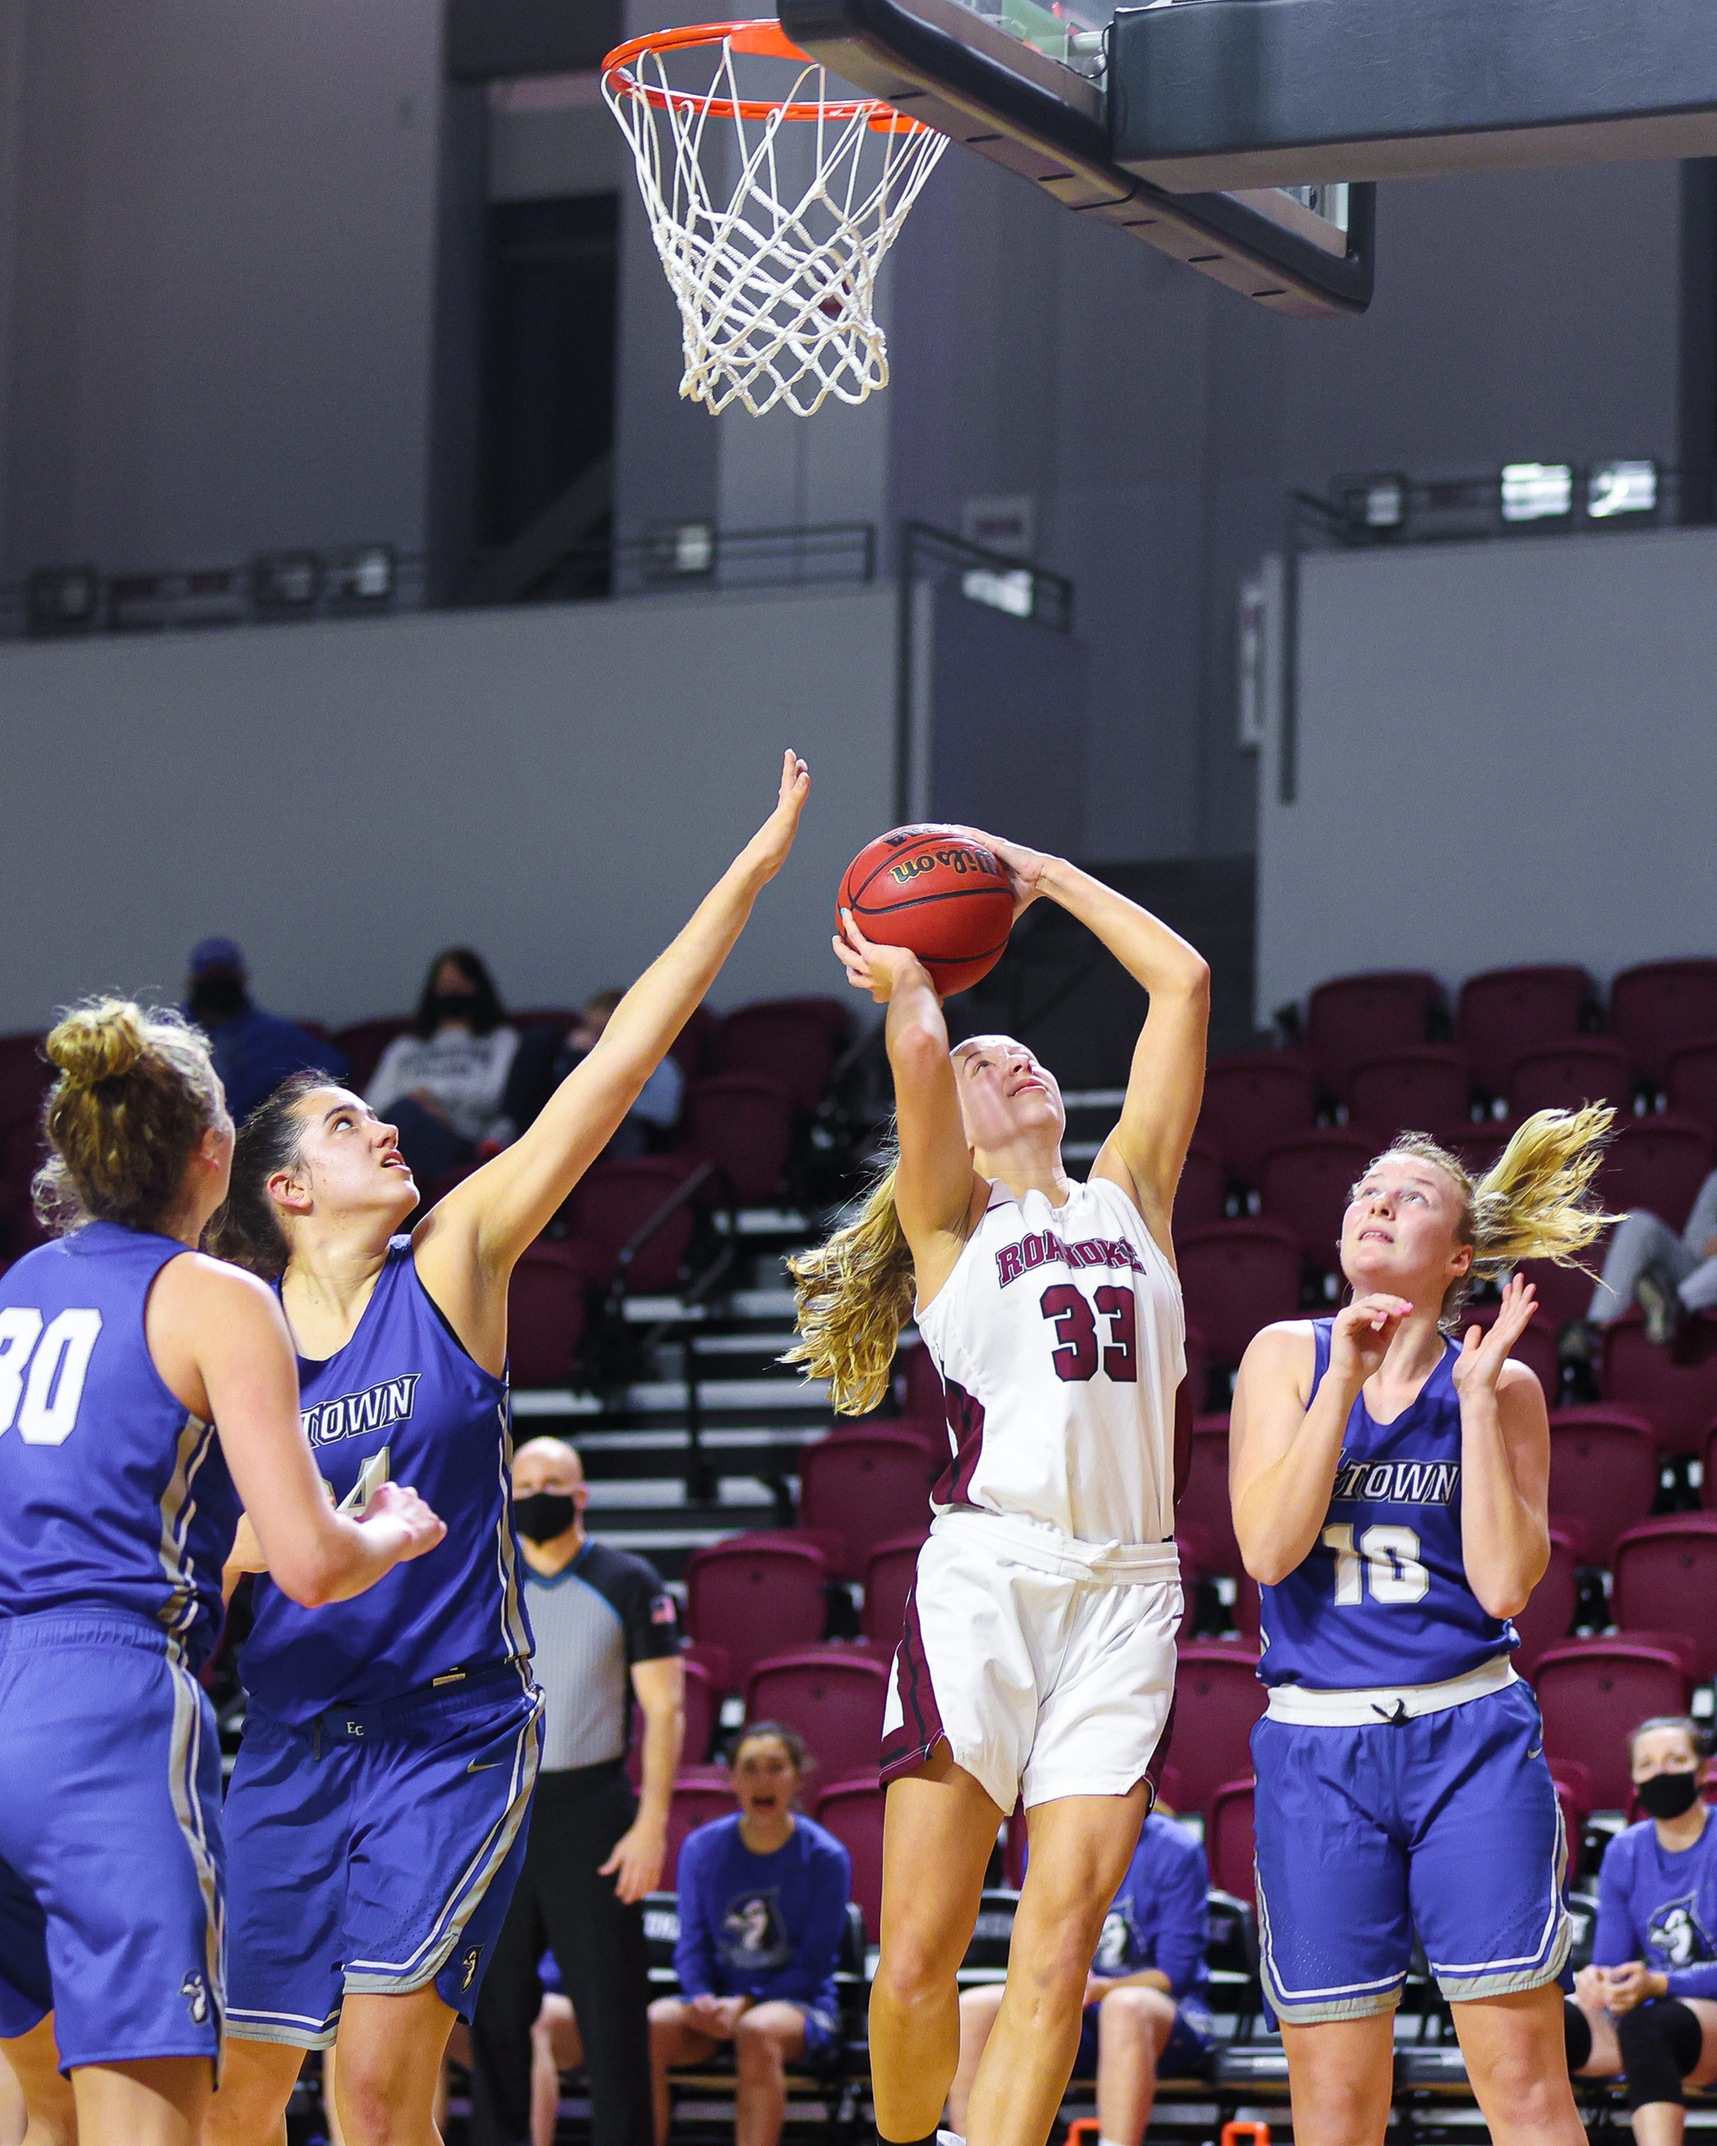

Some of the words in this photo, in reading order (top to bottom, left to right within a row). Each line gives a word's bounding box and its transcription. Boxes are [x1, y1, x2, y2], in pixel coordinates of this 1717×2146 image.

[890, 849, 1000, 883] Wilson
[1039, 1284, 1138, 1383] 33
[1333, 1450, 1460, 1505] TOWN
